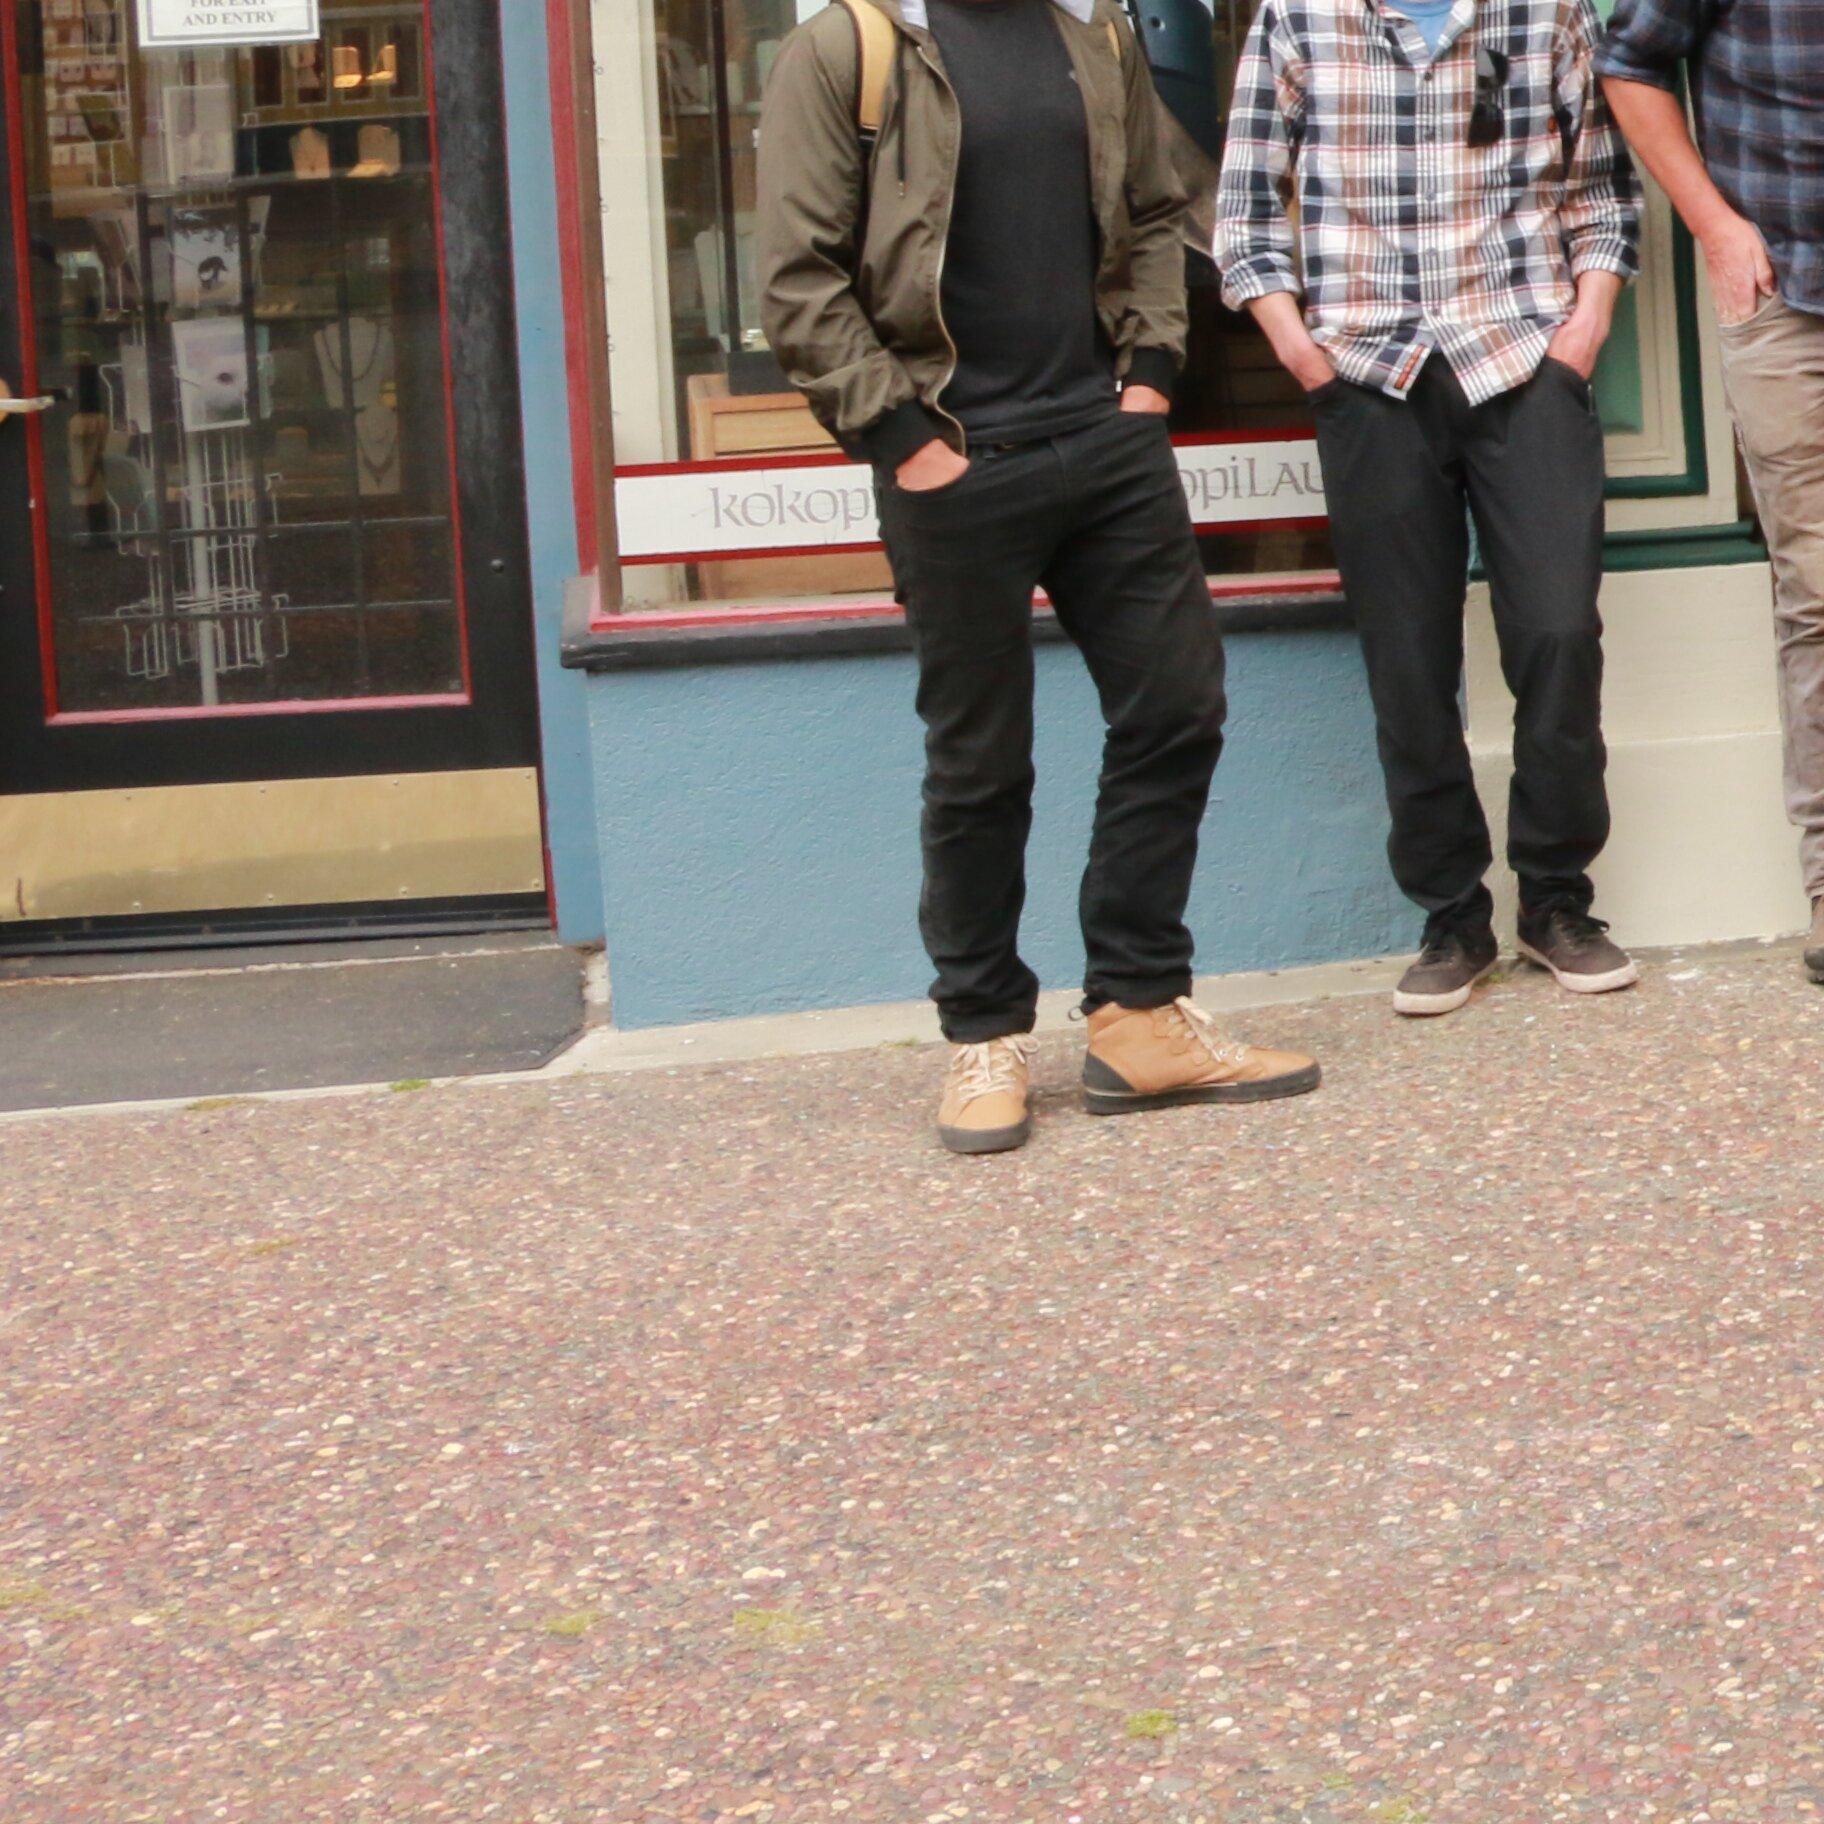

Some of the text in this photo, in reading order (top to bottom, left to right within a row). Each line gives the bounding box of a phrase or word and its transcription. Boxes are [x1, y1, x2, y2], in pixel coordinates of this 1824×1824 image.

[182, 10, 277, 27] AND ENTRY
[709, 484, 871, 531] kokop
